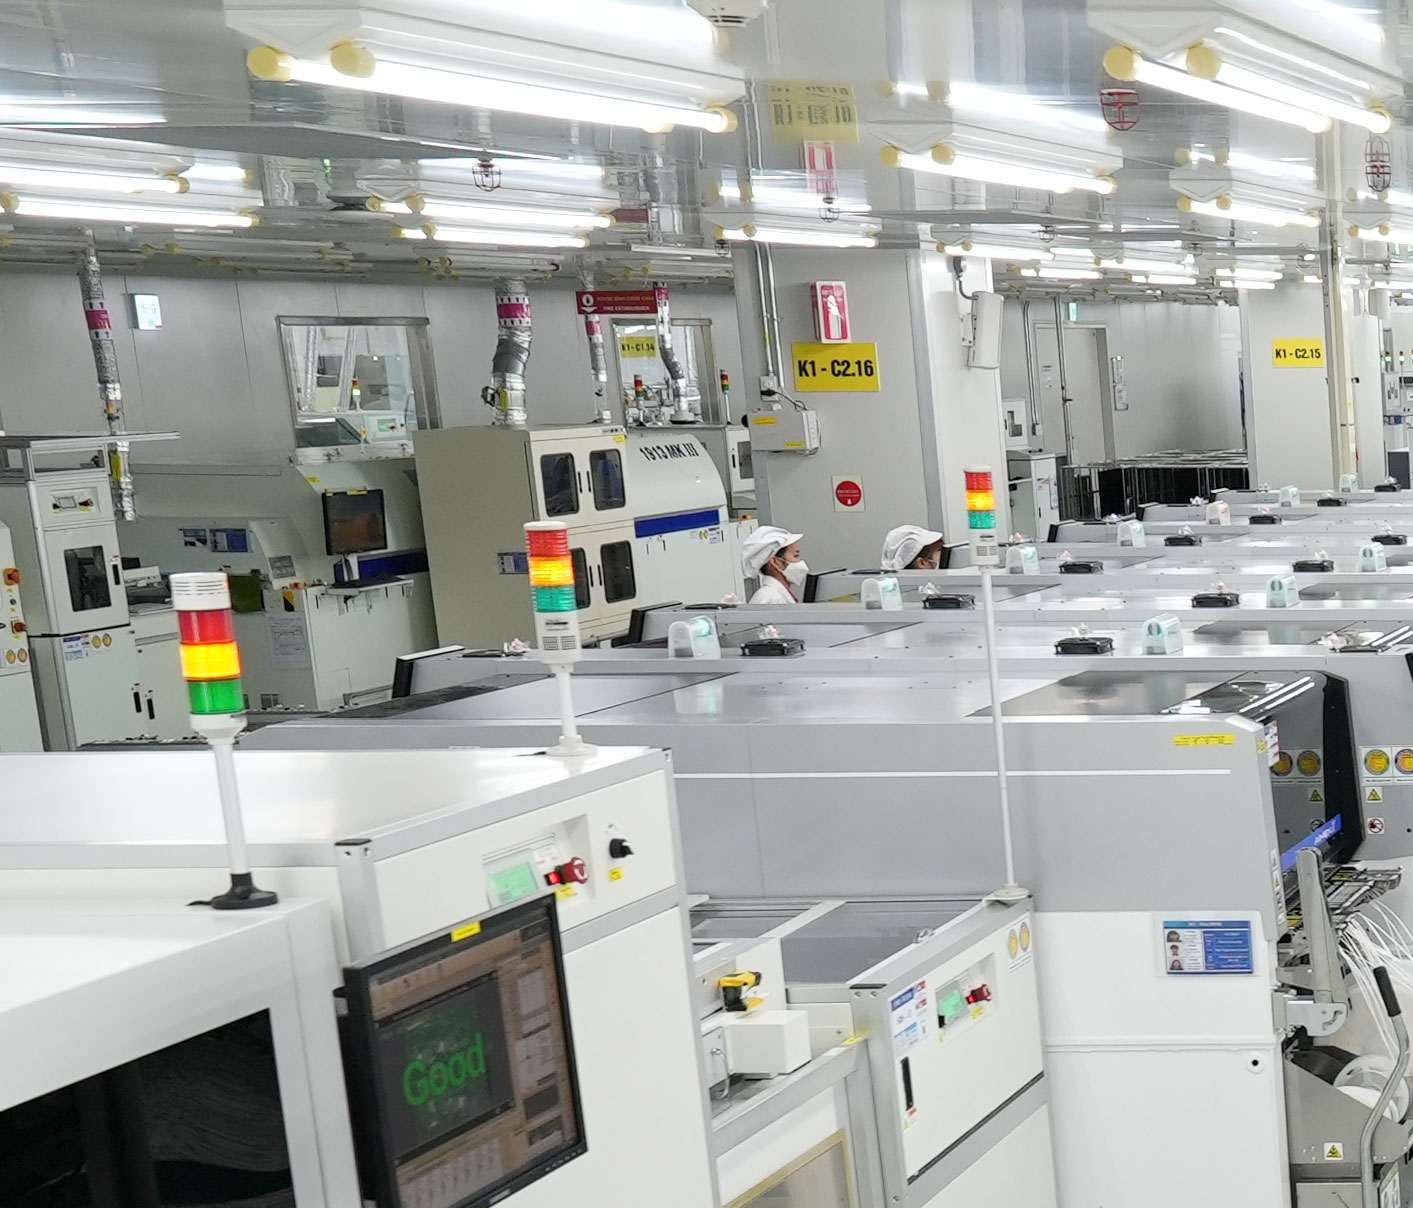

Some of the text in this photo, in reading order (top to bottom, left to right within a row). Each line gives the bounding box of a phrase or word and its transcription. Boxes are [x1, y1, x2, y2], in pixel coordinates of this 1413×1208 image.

[1275, 348, 1287, 360] K1
[1295, 348, 1322, 360] C2.15
[798, 360, 816, 377] K1
[830, 359, 874, 377] C2.16
[639, 445, 669, 461] 1913
[404, 1032, 486, 1106] Good
